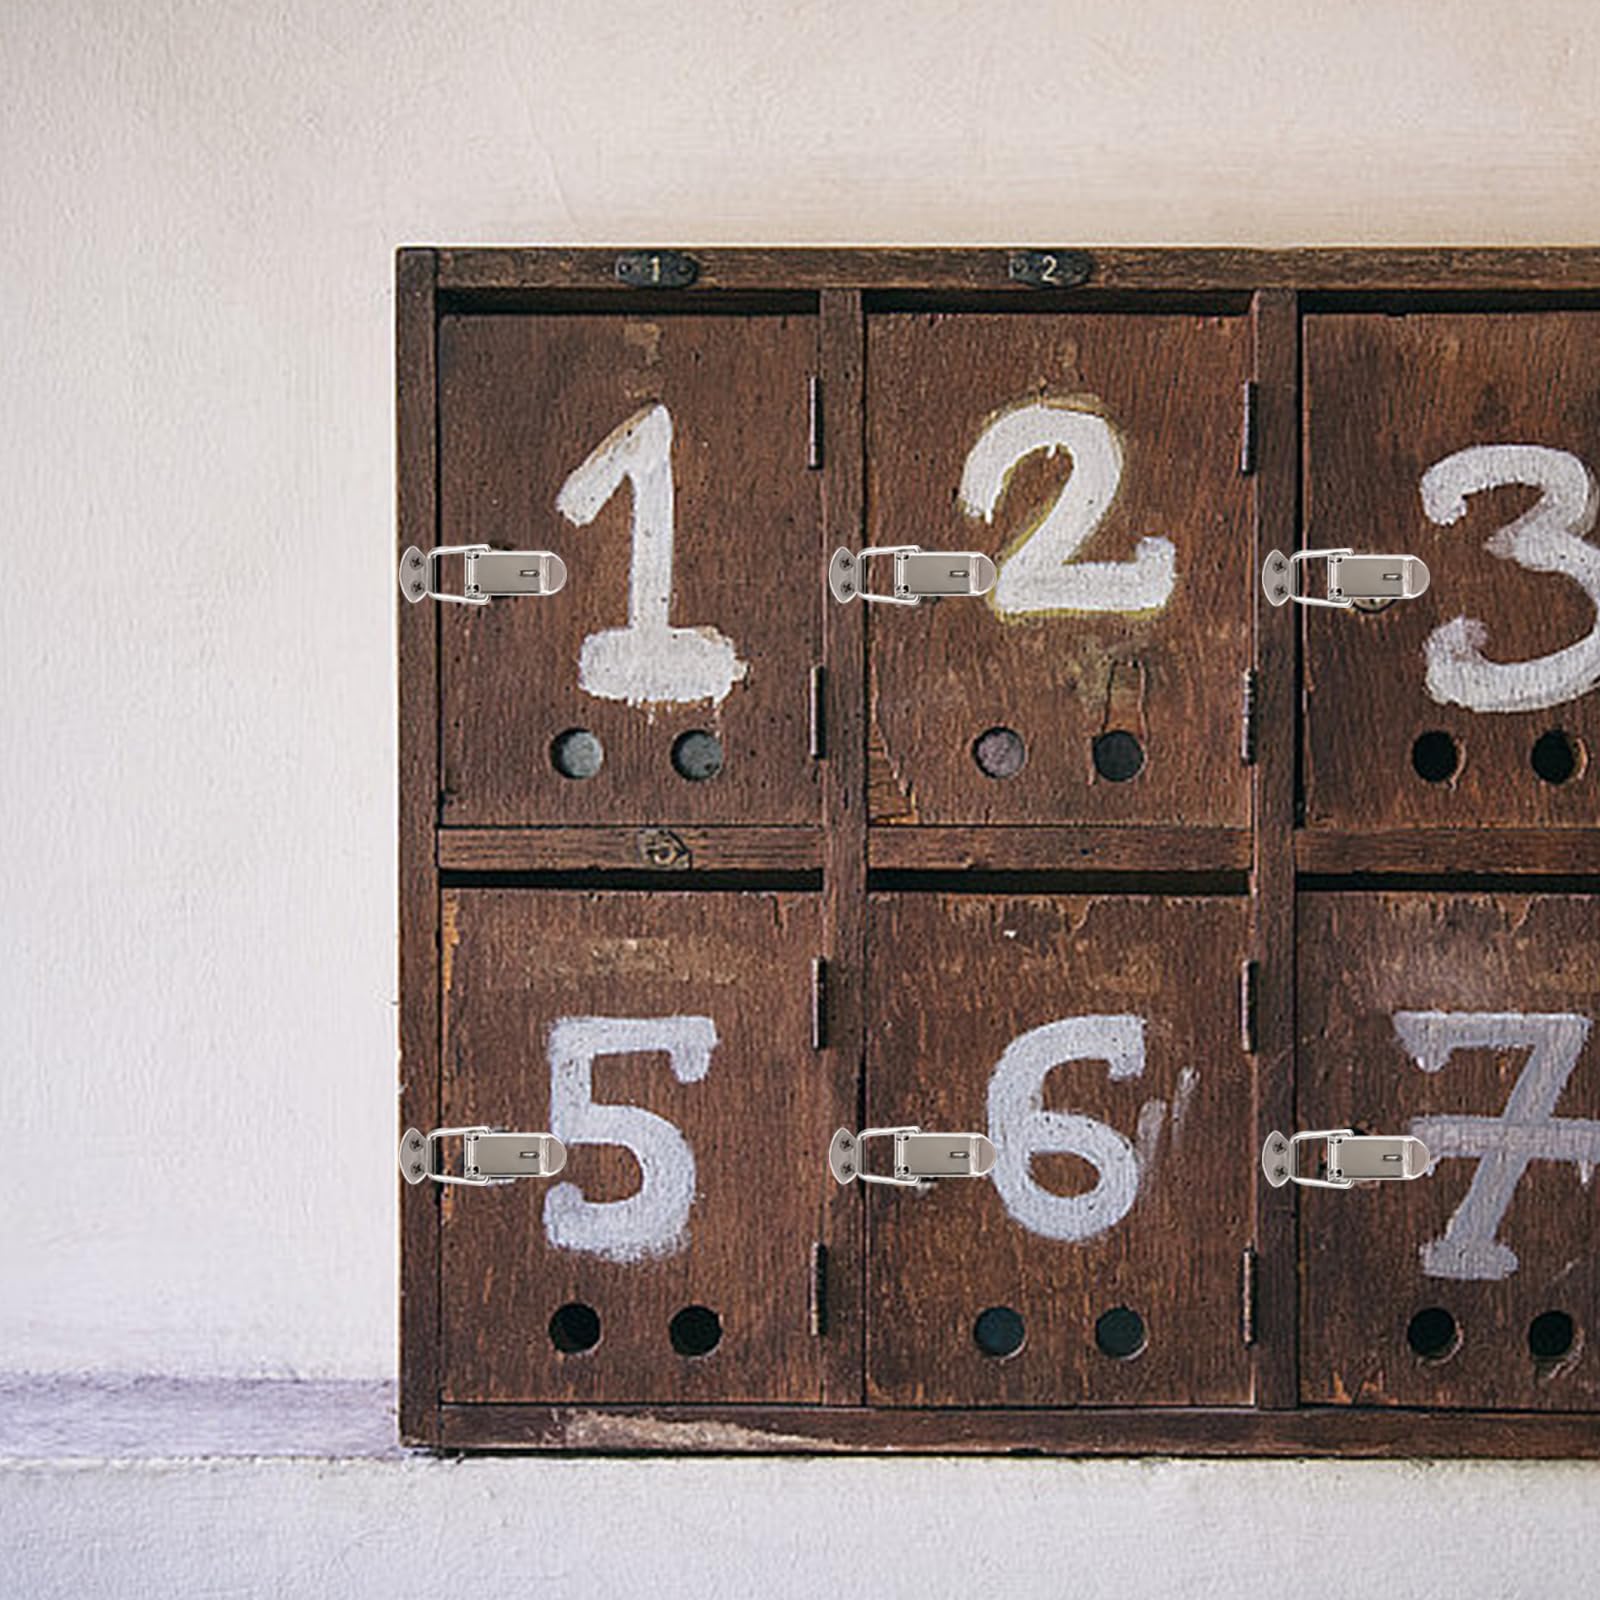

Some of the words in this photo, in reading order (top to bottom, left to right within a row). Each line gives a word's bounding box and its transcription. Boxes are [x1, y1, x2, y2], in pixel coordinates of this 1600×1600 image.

[650, 256, 660, 282] 1
[1041, 255, 1057, 281] 2
[556, 403, 748, 706] 1
[959, 401, 1177, 617] 2
[1420, 443, 1600, 714] 3
[543, 1015, 719, 1263] 5
[987, 1013, 1148, 1243] 6
[1393, 1010, 1600, 1281] 7
